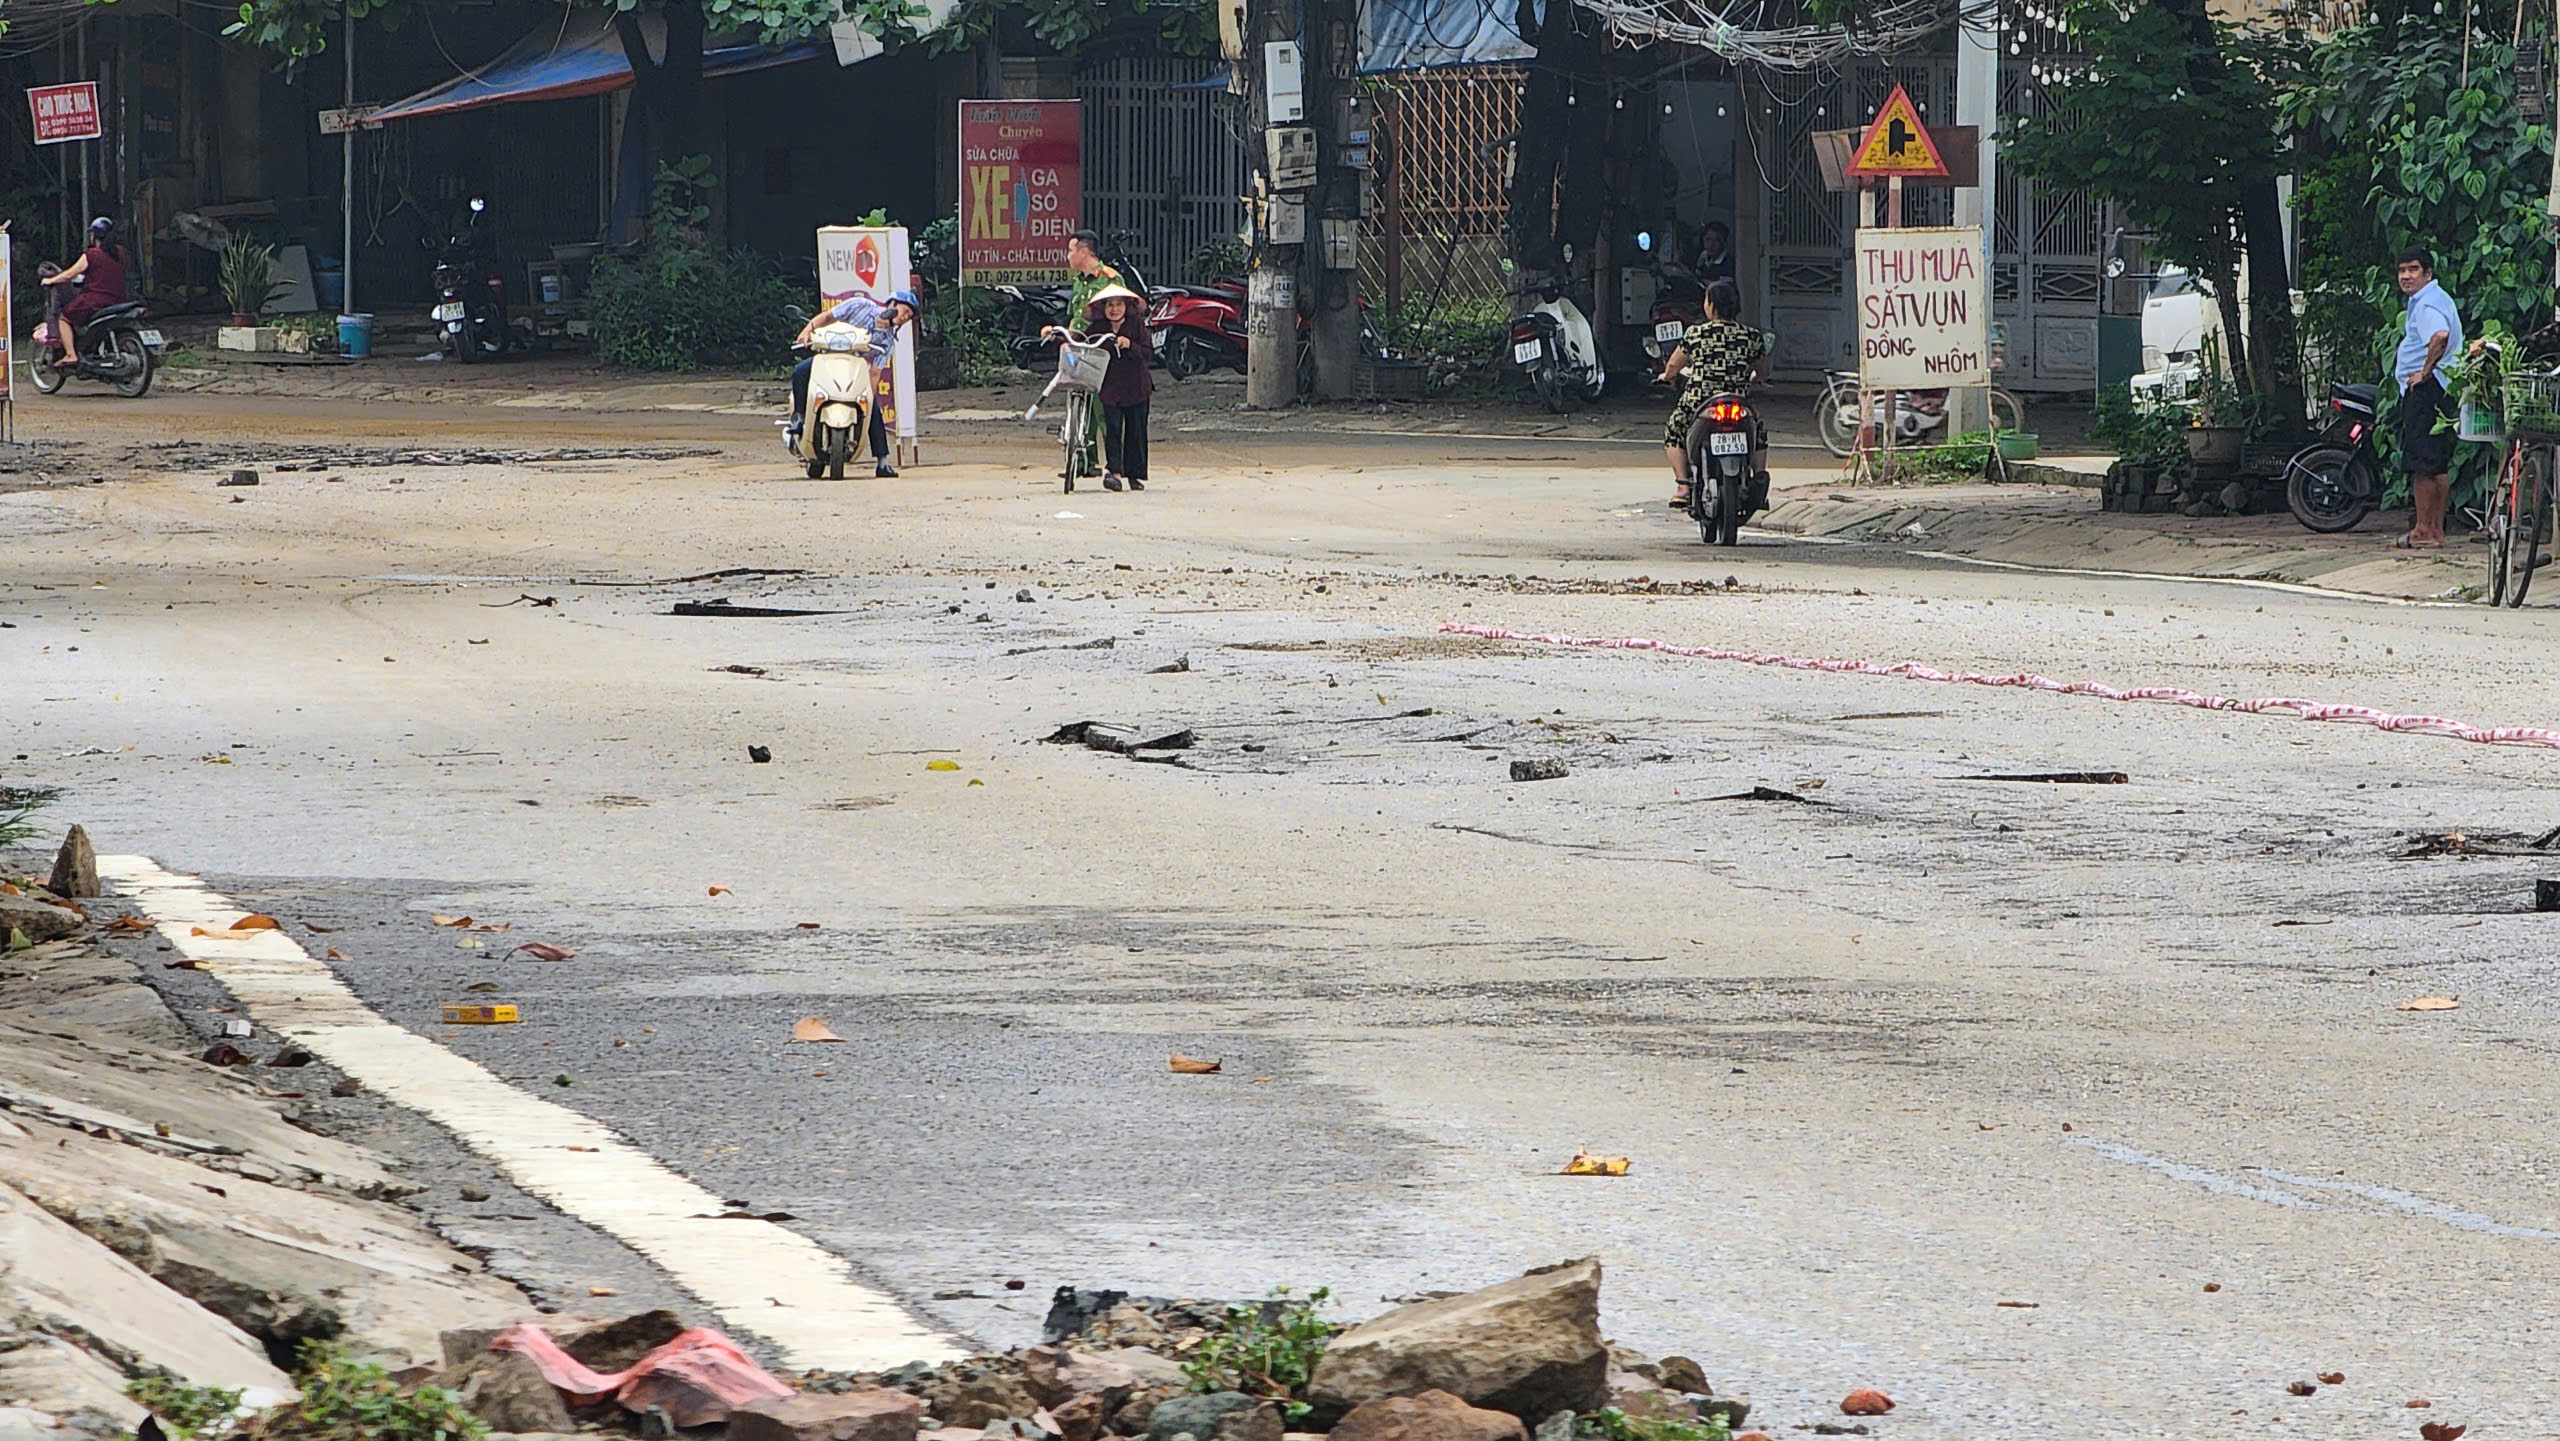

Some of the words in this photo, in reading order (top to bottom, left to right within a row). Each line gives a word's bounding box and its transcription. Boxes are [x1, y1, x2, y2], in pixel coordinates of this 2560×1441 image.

[966, 145, 987, 161] SỬA
[989, 146, 1020, 161] CHỮA
[1031, 168, 1059, 187] GA
[969, 166, 1010, 239] XE
[1031, 216, 1075, 241] ĐIỆN
[826, 249, 855, 273] NEW
[967, 249, 980, 263] UY
[982, 246, 999, 263] TÍN
[1863, 249, 1914, 285] THU
[1921, 247, 1975, 283] MUA
[996, 270, 1023, 283] 0972
[1026, 270, 1046, 283] 544
[1049, 270, 1069, 282] 738
[1865, 329, 1916, 359] ĐỒNG
[1924, 347, 1978, 373] NHÔM
[1714, 443, 1745, 453] 082.50
